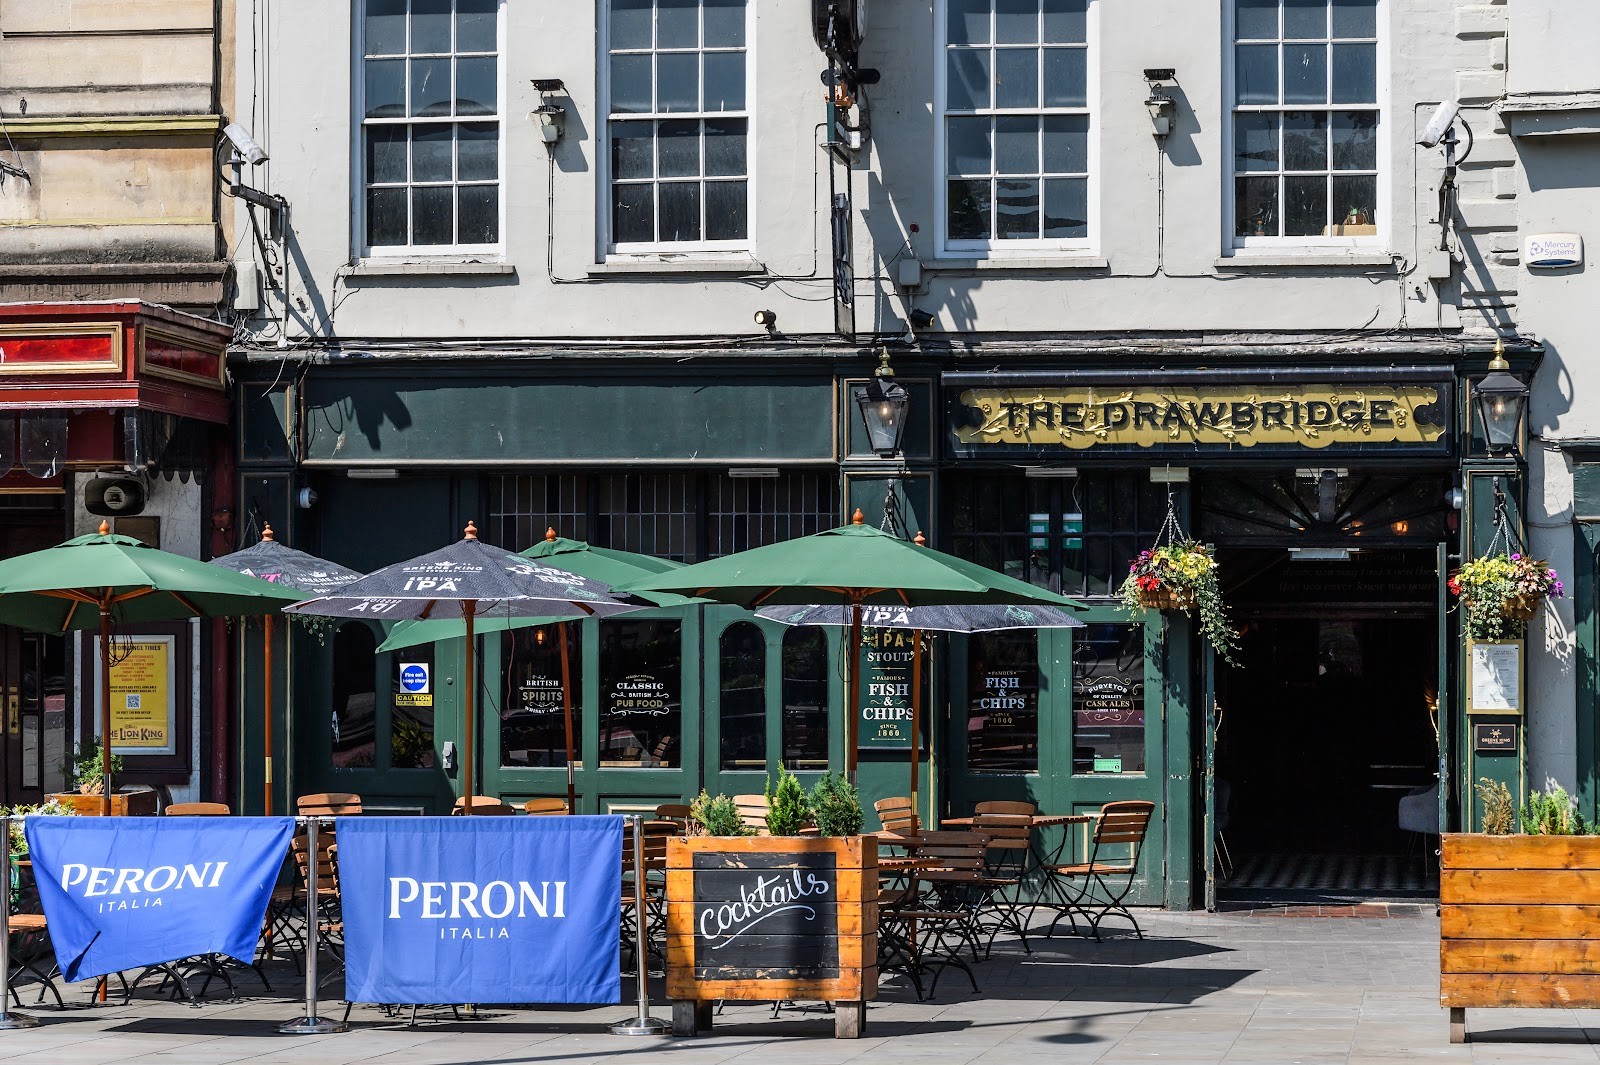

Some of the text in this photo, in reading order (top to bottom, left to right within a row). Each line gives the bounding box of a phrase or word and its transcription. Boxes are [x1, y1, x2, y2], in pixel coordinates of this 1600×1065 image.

[1544, 241, 1576, 249] Mercury
[1544, 248, 1576, 257] Systems
[1000, 400, 1395, 428] THE DRAWBRIDGE
[403, 580, 457, 592] IPA
[867, 605, 914, 613] SESSION
[861, 610, 910, 625] IPA
[874, 632, 905, 648] IPA
[867, 651, 910, 662] STOUT
[616, 682, 664, 690] CLASSIC
[985, 677, 1020, 689] FISH
[1088, 683, 1128, 694] PURVEYOR
[868, 683, 909, 696] FISH
[998, 689, 1007, 697] &
[522, 691, 563, 701] SPIRITS
[883, 696, 893, 706] &
[616, 699, 663, 708] PUB FOOD
[980, 697, 1025, 709] CHIPS
[862, 707, 914, 720] CHIPS
[110, 728, 163, 741] HE LION KING
[877, 729, 900, 737] 1860
[60, 861, 229, 898] PERONI
[388, 877, 567, 919] PERONI
[99, 897, 163, 914] ITALIA
[440, 927, 509, 939] ITALIA
